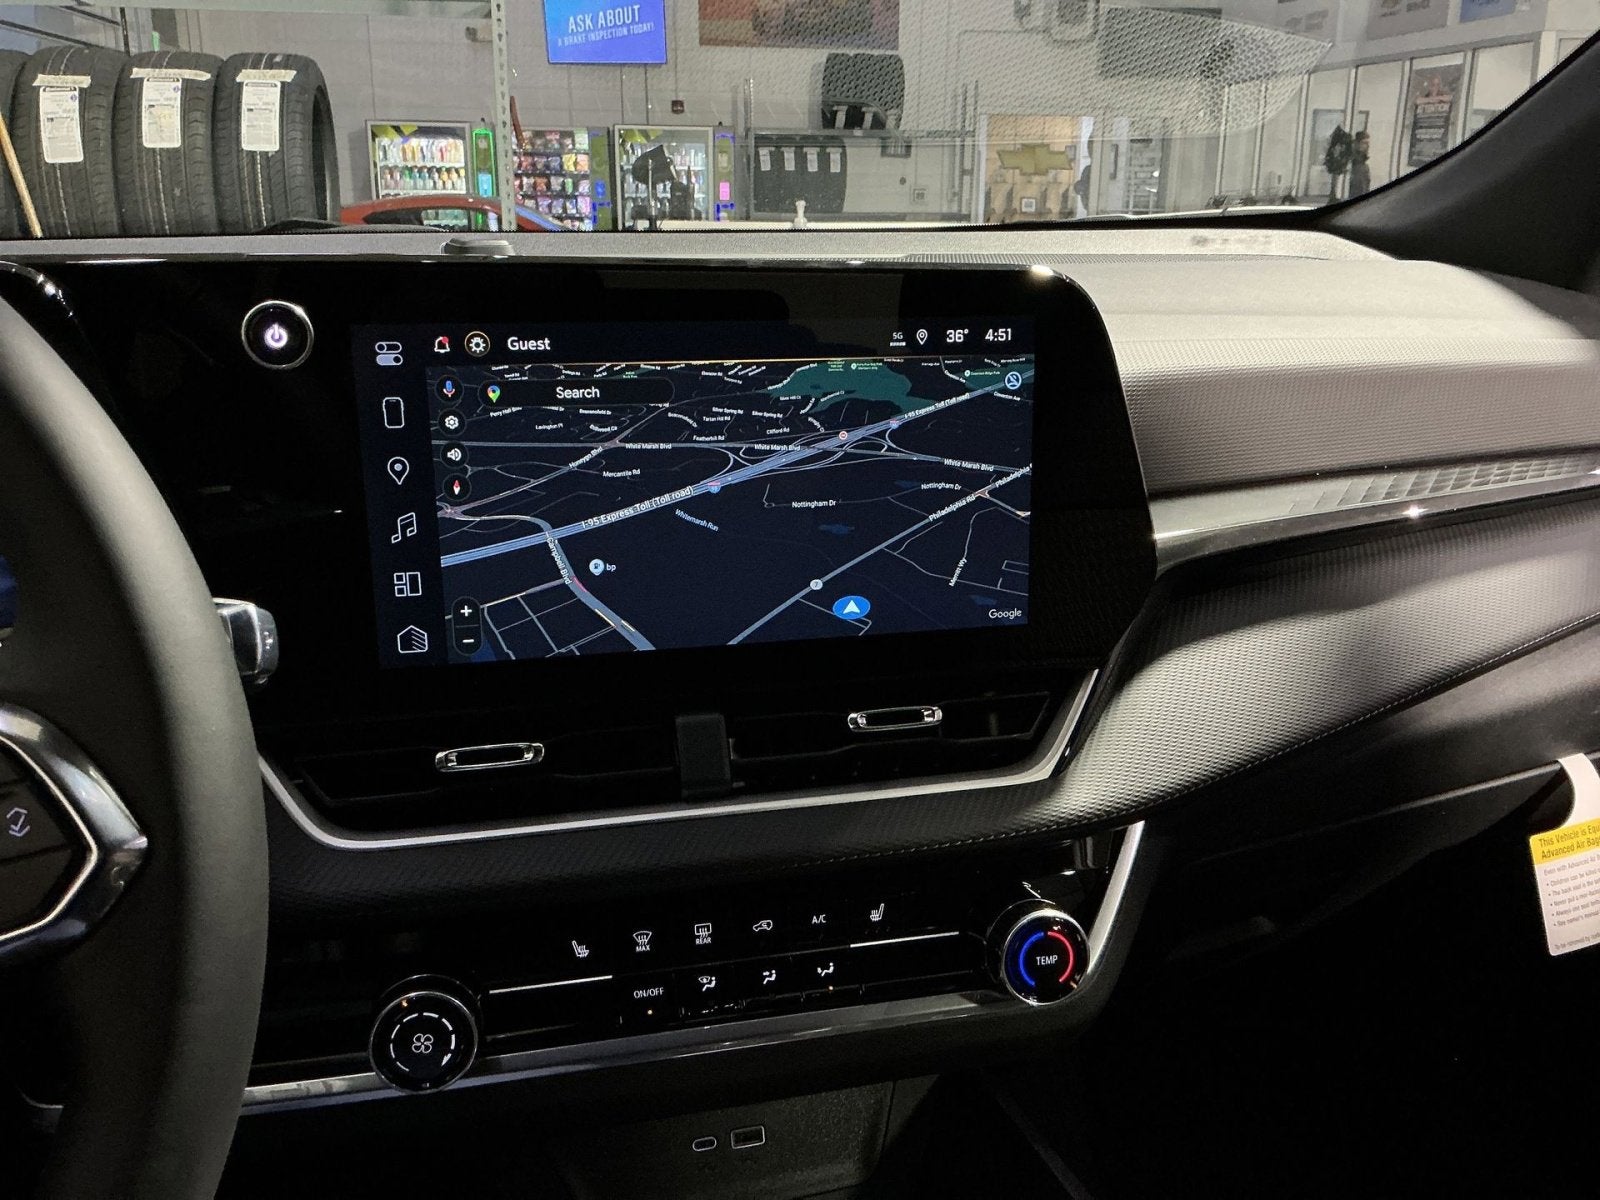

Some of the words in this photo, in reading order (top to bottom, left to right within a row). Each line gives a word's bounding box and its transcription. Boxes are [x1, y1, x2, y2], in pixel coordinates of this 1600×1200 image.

[568, 14, 594, 33] ASK
[598, 4, 640, 28] ABOUT
[588, 28, 628, 42] INSPECTION
[946, 328, 969, 342] 36°
[985, 328, 1012, 341] 4:51
[507, 336, 550, 350] Guest
[556, 386, 600, 398] Search
[944, 458, 961, 467] White
[962, 461, 980, 470] Marsh
[582, 518, 600, 528] I-95
[600, 508, 634, 522] Express
[635, 501, 651, 512] Toll
[652, 494, 672, 508] (Toll
[672, 485, 694, 500] road)
[929, 499, 966, 521] Philadelphia
[966, 494, 975, 503] Rd
[675, 508, 707, 527] Whitemarsh
[707, 522, 719, 532] Run
[547, 538, 565, 570] Campbell
[560, 569, 572, 585] Blvd
[606, 564, 616, 572] bp
[988, 608, 1022, 619] Google
[1538, 837, 1554, 848] This
[1555, 830, 1579, 843] Vehicle
[1542, 844, 1574, 860] Advanced
[1576, 840, 1586, 849] Air
[812, 914, 826, 924] A/C
[696, 937, 712, 945] REAR
[1036, 955, 1058, 966] TEMP
[634, 987, 664, 999] ON/OFF
